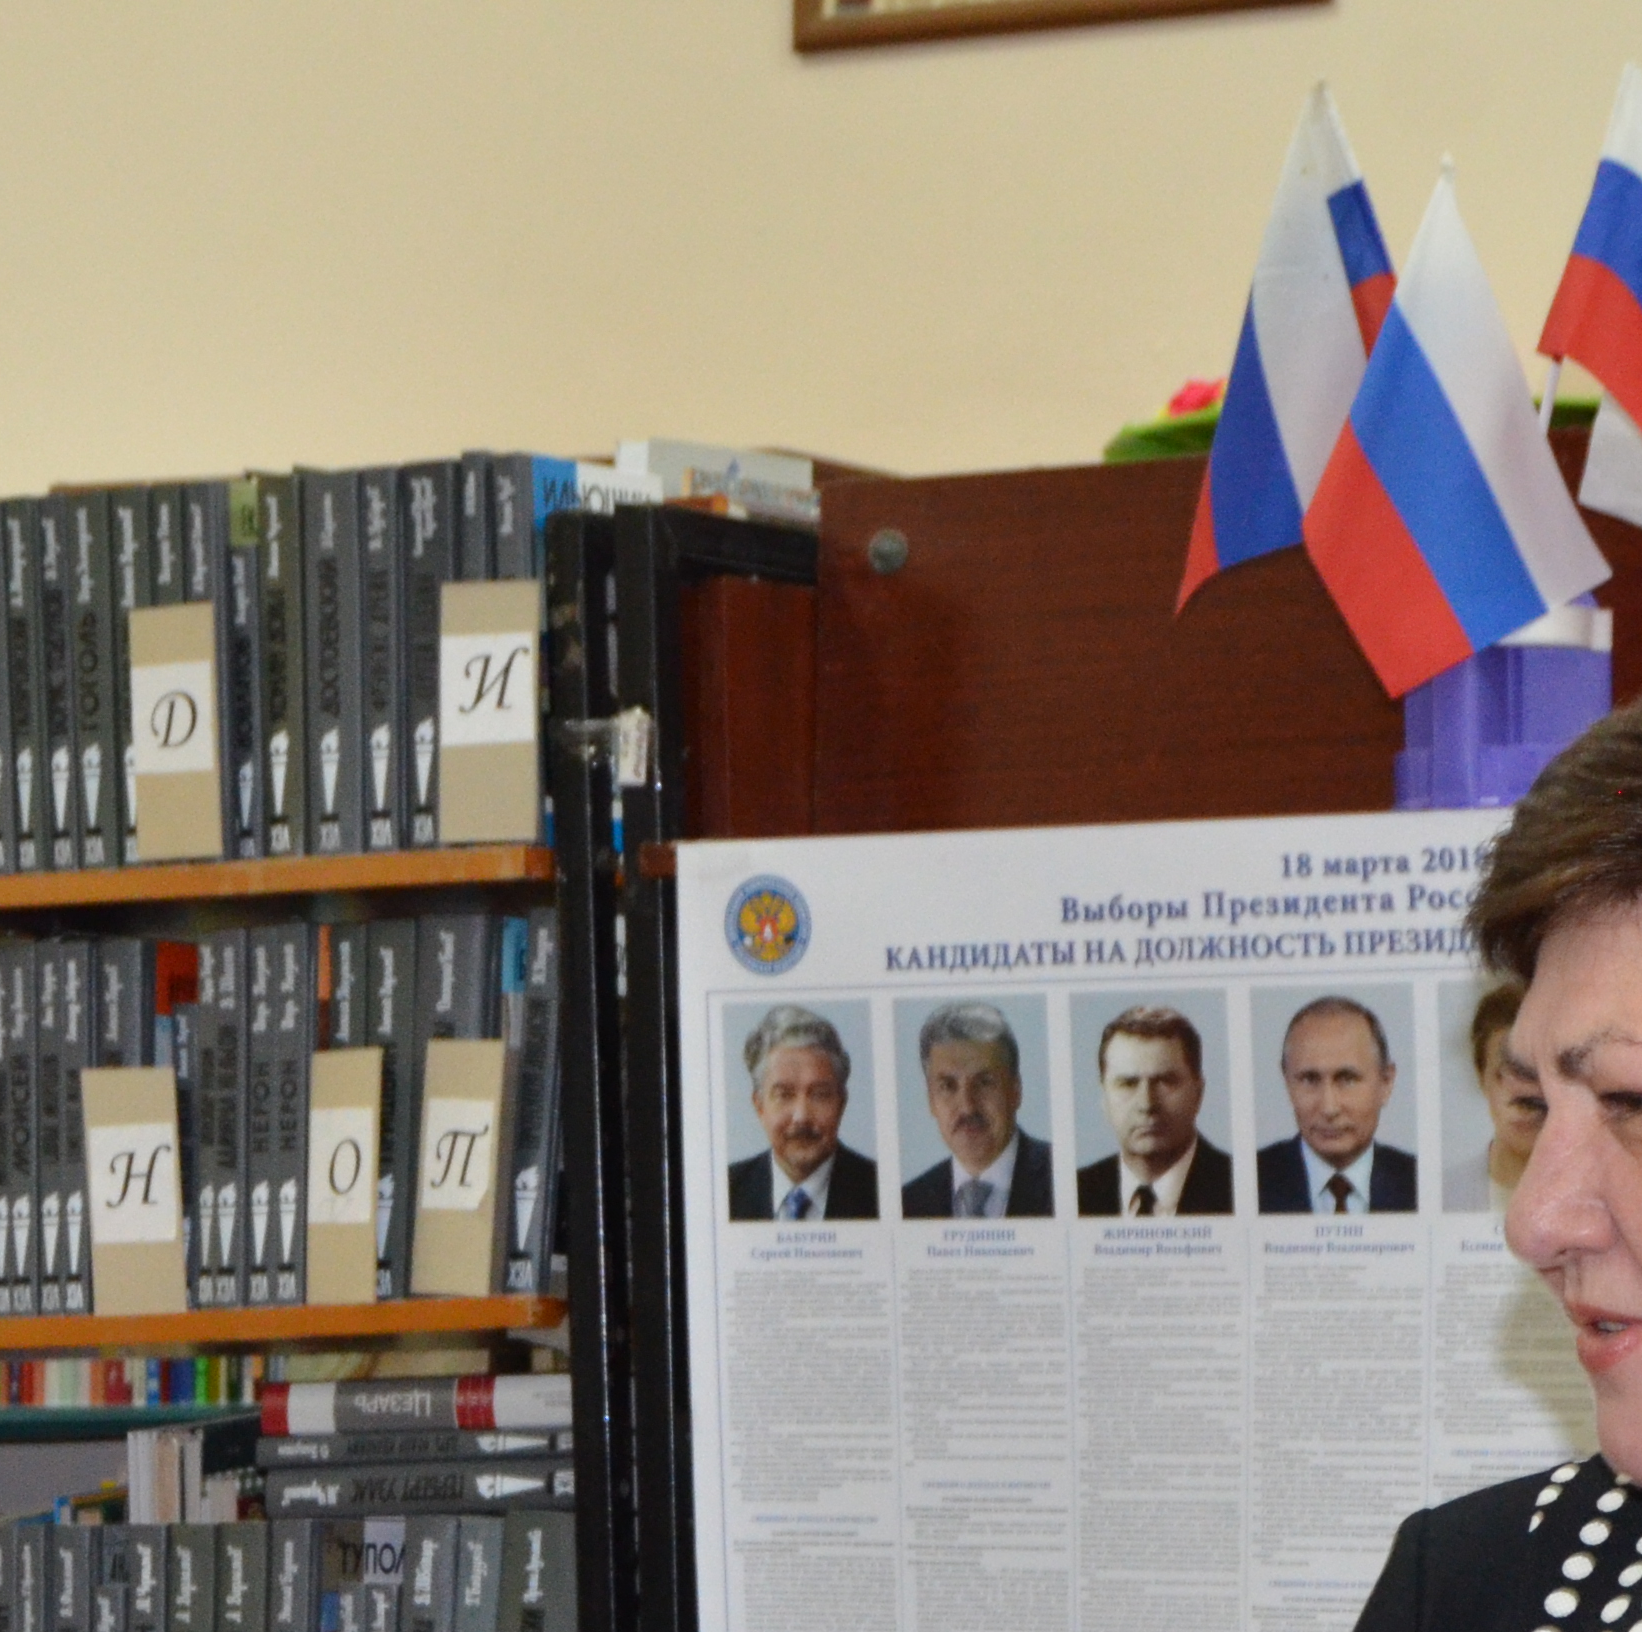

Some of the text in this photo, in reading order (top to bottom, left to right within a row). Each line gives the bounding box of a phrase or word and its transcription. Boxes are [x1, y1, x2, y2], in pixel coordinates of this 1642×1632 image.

[318, 558, 340, 719] ДОСТОЕВСКИЙ
[79, 611, 100, 732] ГОГОЛЬ
[460, 646, 529, 712] И
[1280, 853, 1312, 879] 18
[1323, 852, 1409, 882] марта
[1061, 890, 1394, 925] Выборы Президента
[886, 932, 1336, 972] КАНДИДАТЫ НА ДОЛЖНОСТЬ
[10, 1053, 30, 1176] МОИСЕЙ
[253, 1061, 269, 1153] НЕРОН
[280, 1059, 298, 1151] НЕРОН
[106, 1144, 171, 1208] Н
[329, 1139, 361, 1194] О
[430, 1126, 489, 1189] П
[776, 1231, 837, 1244] БАБУРИН
[943, 1230, 1016, 1242] ГРУДИНИН
[1094, 1241, 1222, 1257] Владимир Вольфович
[1103, 1227, 1212, 1241] ЖИРИНОВСКИЙ
[1264, 1241, 1415, 1256] Владимир Владимирович
[1314, 1226, 1363, 1239] ПУТИН
[751, 1247, 863, 1261] Сергей Николаевич
[927, 1245, 1035, 1258] Павел Николаевич
